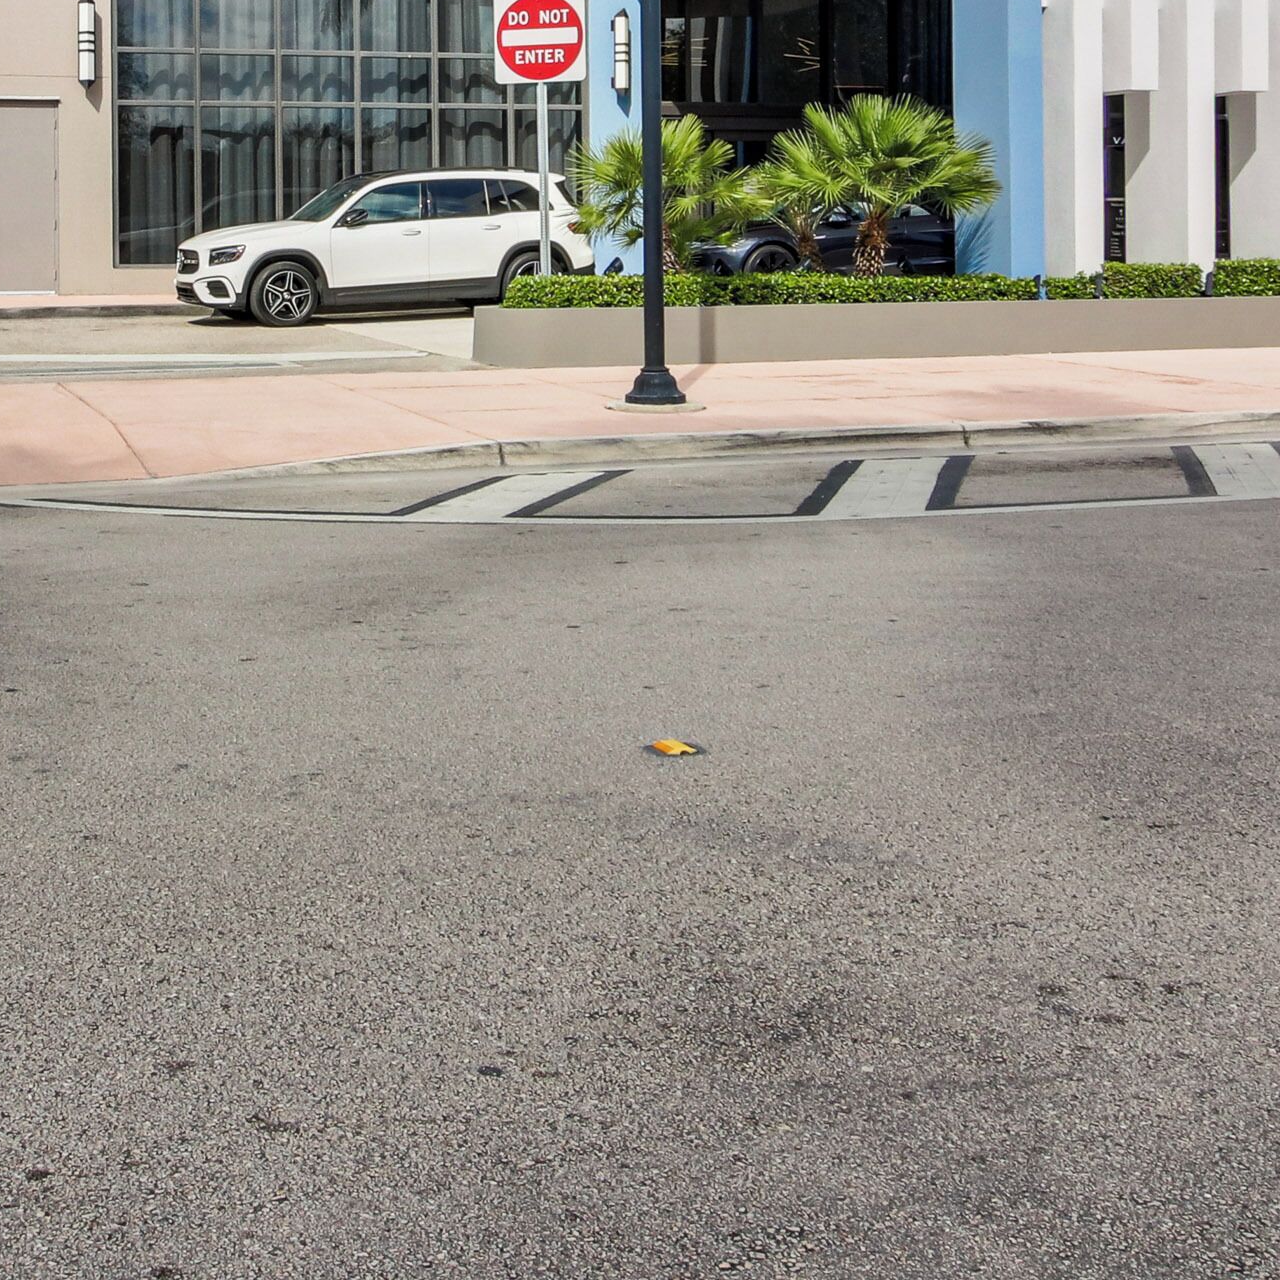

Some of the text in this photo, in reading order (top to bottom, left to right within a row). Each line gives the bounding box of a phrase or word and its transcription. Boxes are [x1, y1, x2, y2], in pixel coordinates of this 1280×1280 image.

[508, 8, 569, 26] DO NOT
[515, 48, 565, 65] ENTER
